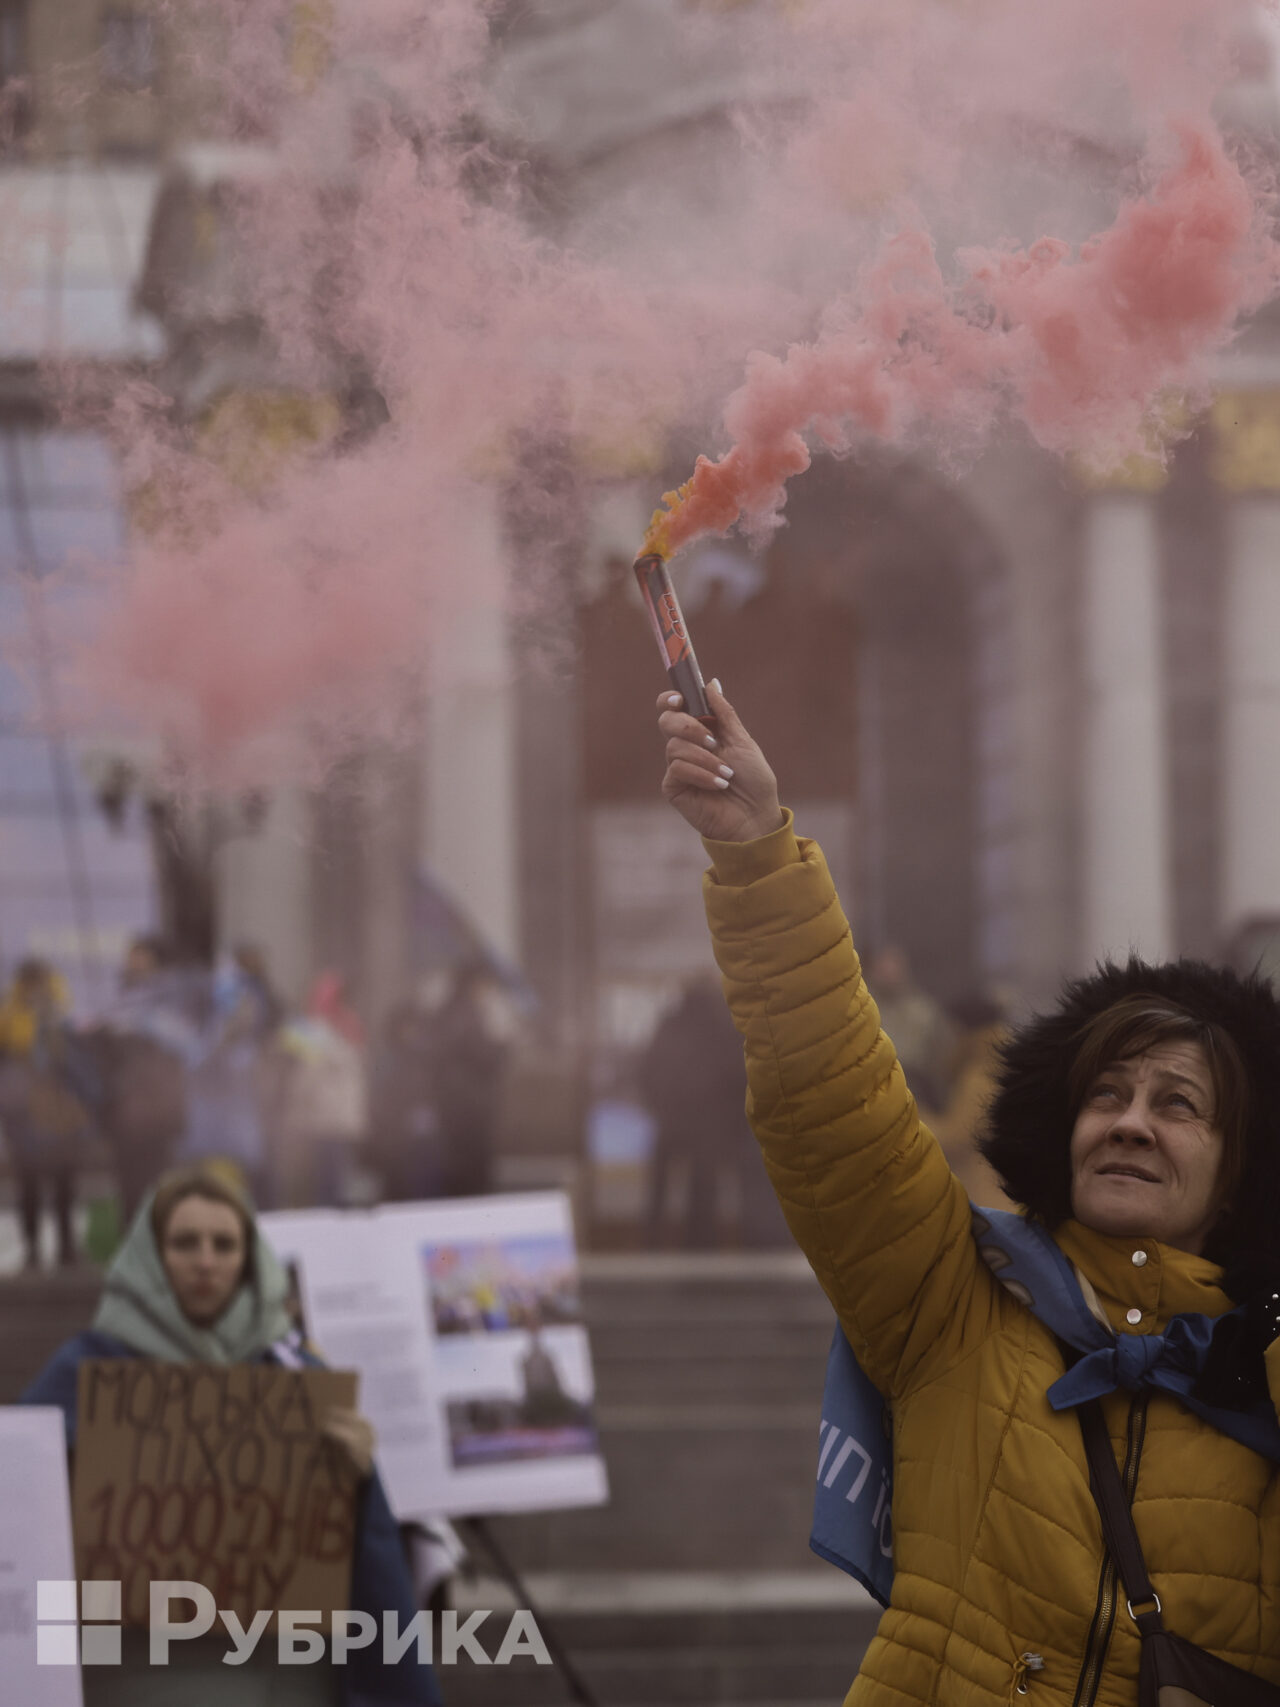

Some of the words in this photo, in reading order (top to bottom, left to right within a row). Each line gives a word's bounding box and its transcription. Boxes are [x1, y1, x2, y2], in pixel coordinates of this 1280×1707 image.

[87, 1364, 317, 1442] МОРСЬКА
[131, 1428, 345, 1494] ПІХОТА
[89, 1484, 224, 1557] 1000
